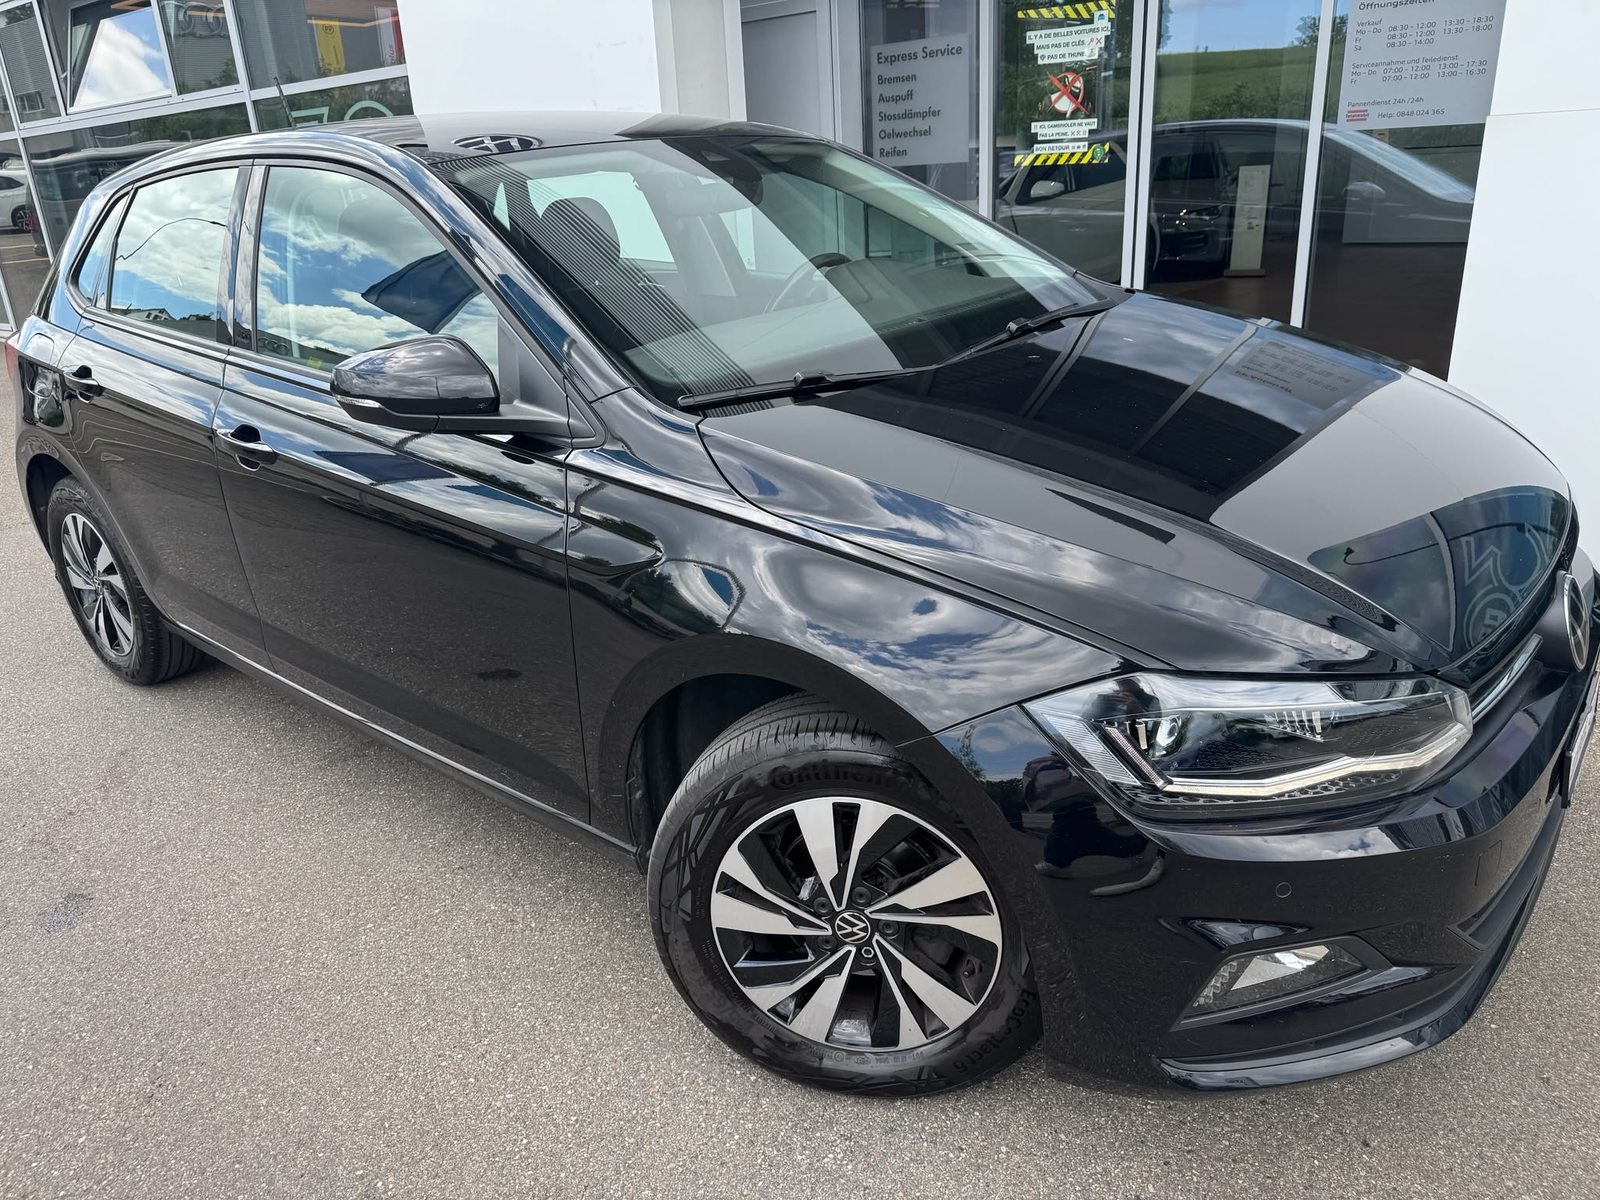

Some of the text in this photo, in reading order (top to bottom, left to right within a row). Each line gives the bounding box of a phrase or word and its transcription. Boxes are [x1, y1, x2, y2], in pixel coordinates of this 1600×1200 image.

[1357, 18, 1382, 27] Verkauf
[1074, 27, 1100, 35] VOITURES
[877, 44, 963, 66] Express Service
[1352, 60, 1405, 69] Serviceannahme
[1422, 55, 1458, 63] Teiledienst
[877, 74, 917, 85] Bremsen
[878, 89, 914, 104] Auspuff
[1348, 98, 1391, 108] Pannendienst
[878, 106, 941, 122] Stossdämpfer
[878, 125, 932, 139] Oelwechsel
[879, 147, 907, 158] Reifen
